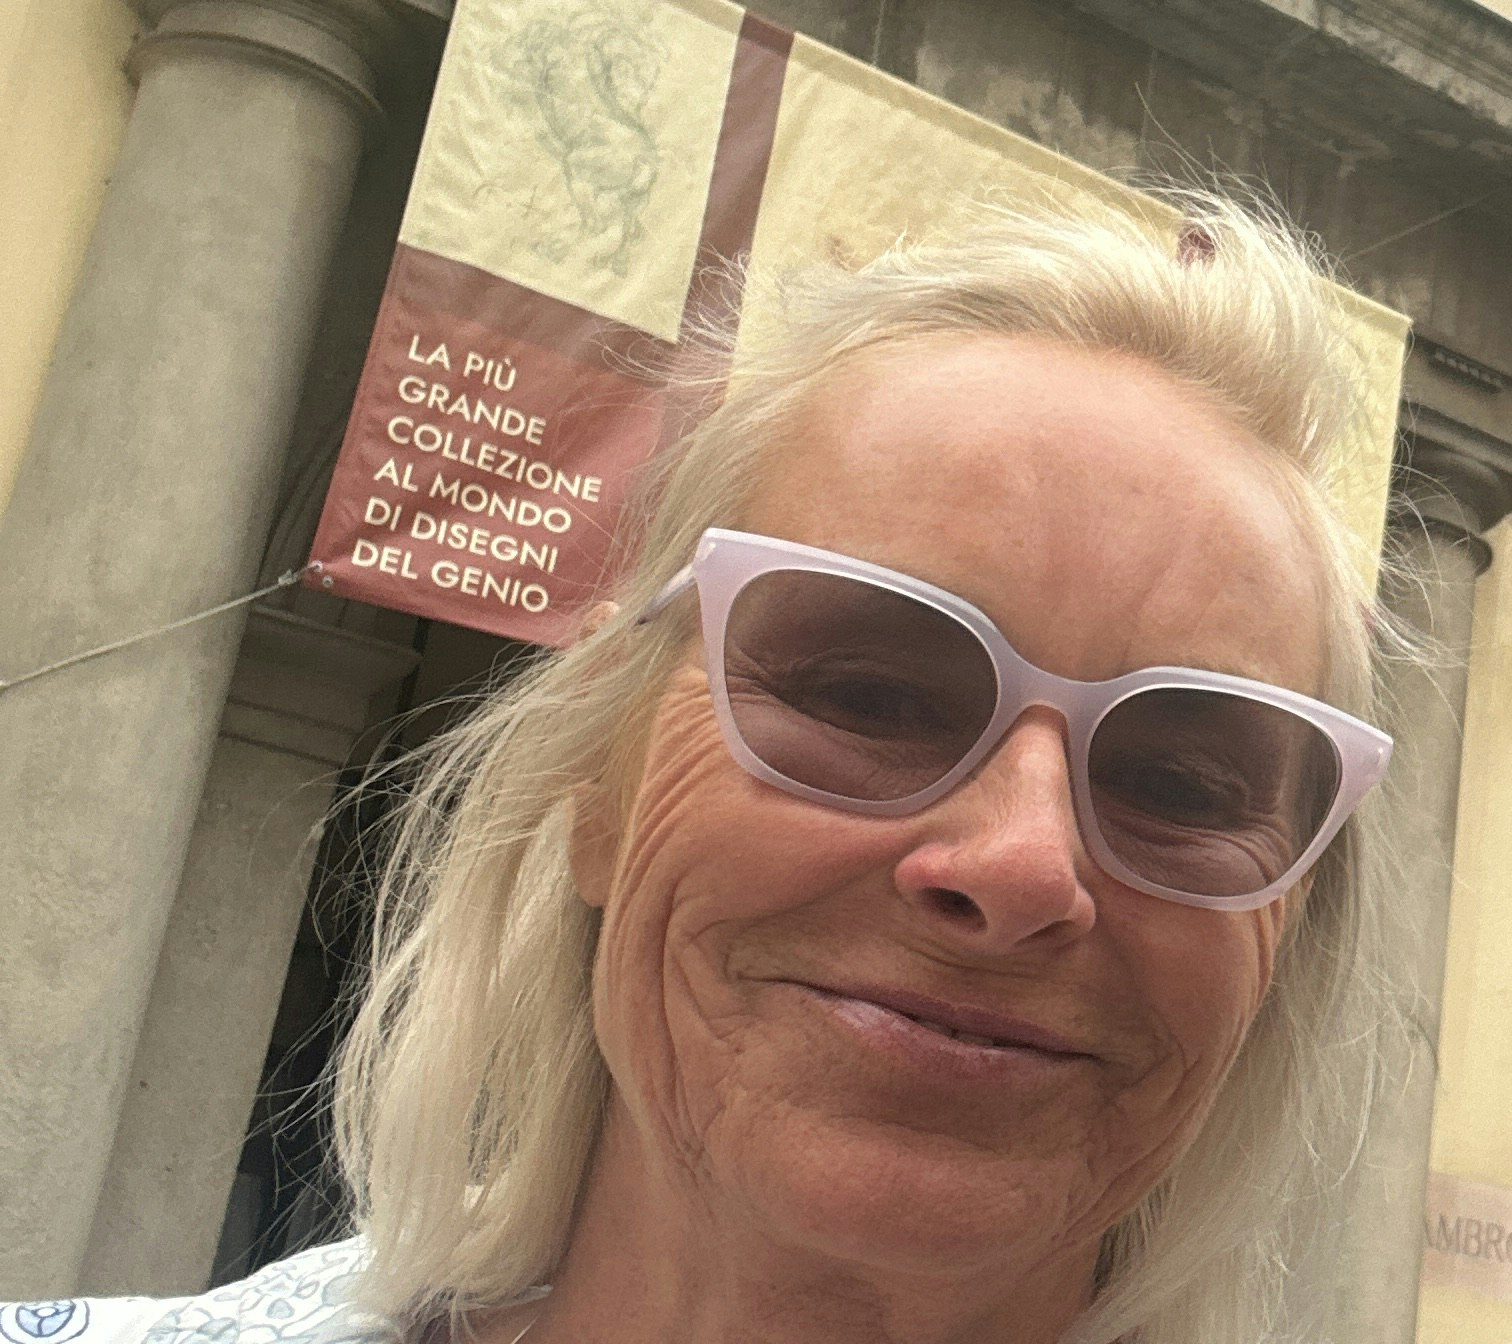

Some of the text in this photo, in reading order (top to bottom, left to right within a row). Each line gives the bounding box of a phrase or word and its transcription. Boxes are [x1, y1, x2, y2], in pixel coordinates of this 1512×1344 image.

[407, 334, 517, 392] LA PIÙ
[398, 375, 548, 445] GRANDE
[374, 457, 572, 534] AL MONDO
[387, 416, 603, 503] COLLEZIONE
[364, 497, 559, 573] DI DISEGNI
[351, 540, 550, 613] DEL GENIO
